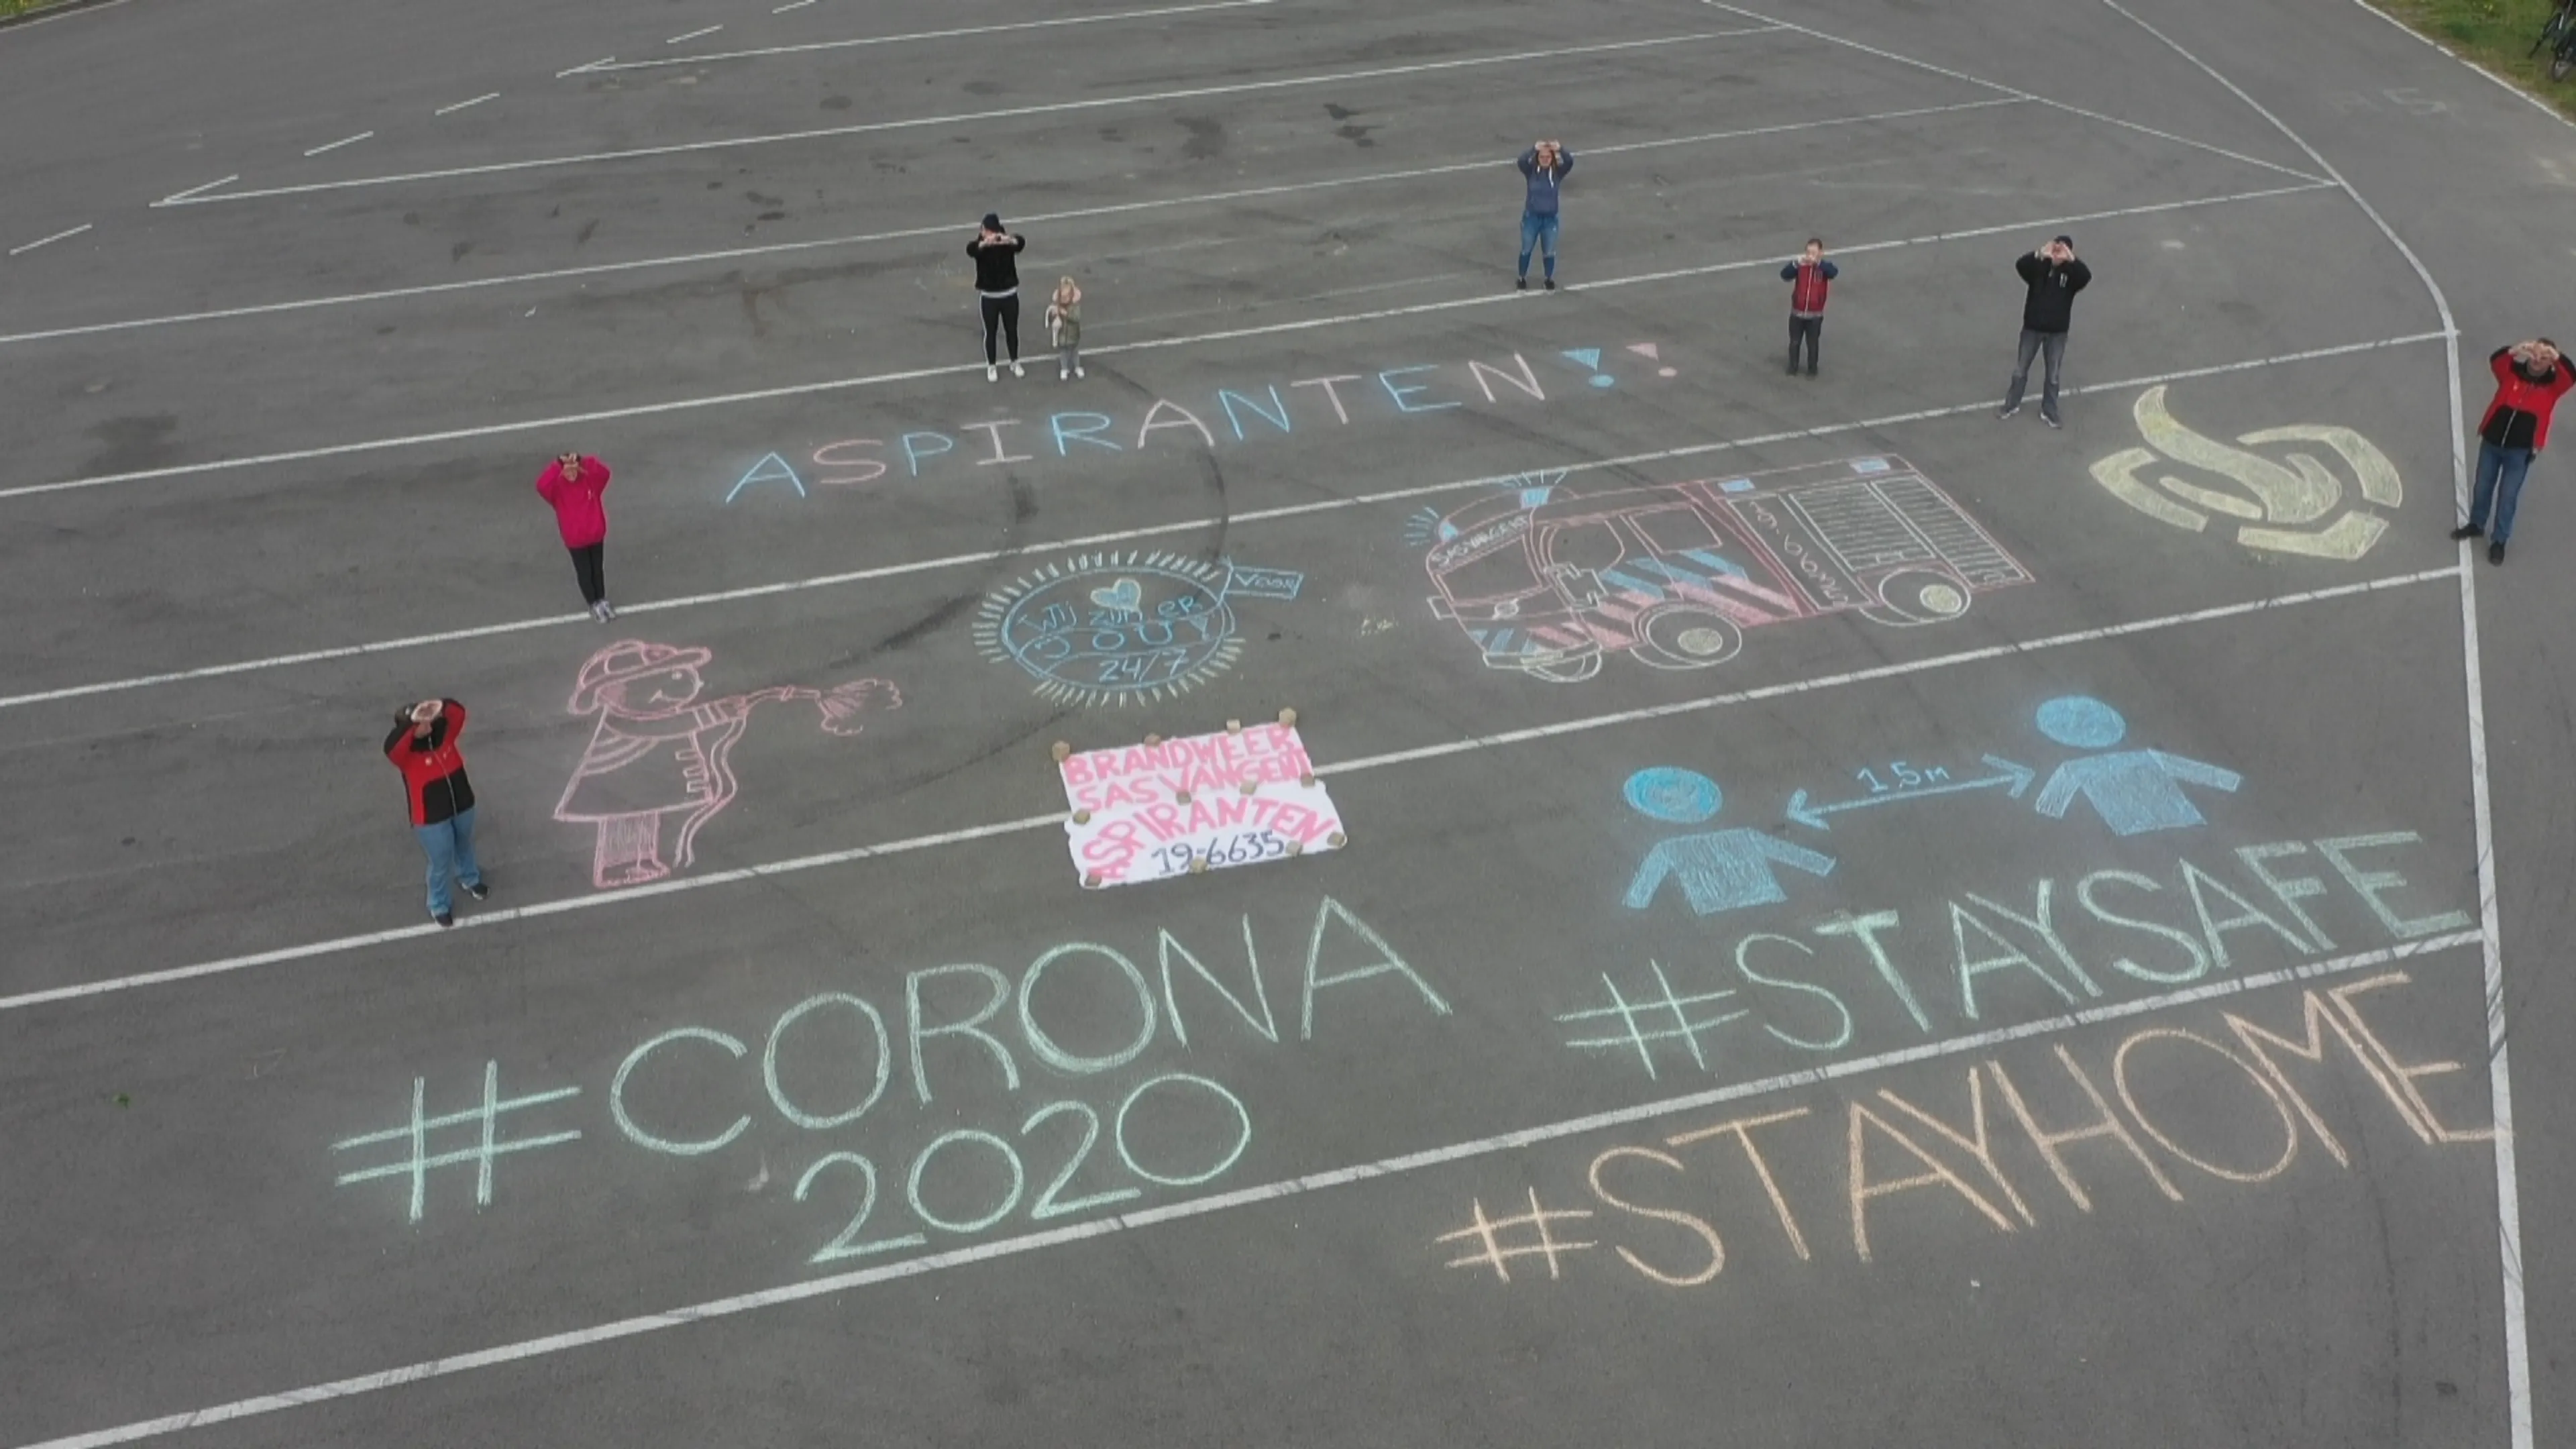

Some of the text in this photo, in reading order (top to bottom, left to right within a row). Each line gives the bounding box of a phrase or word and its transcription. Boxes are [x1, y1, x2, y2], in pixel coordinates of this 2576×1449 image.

[1064, 724, 1295, 786] BRANDWEER
[1076, 776, 1159, 812] SAS
[1082, 796, 1338, 879] ASPIRANTEN
[1150, 829, 1285, 875] 19-6635
[1552, 830, 2474, 1081] #STAYSAFE
[331, 896, 1453, 1224] #CORONA
[794, 1073, 1250, 1263] 2020
[1435, 970, 2498, 1288] #STAYHOME
